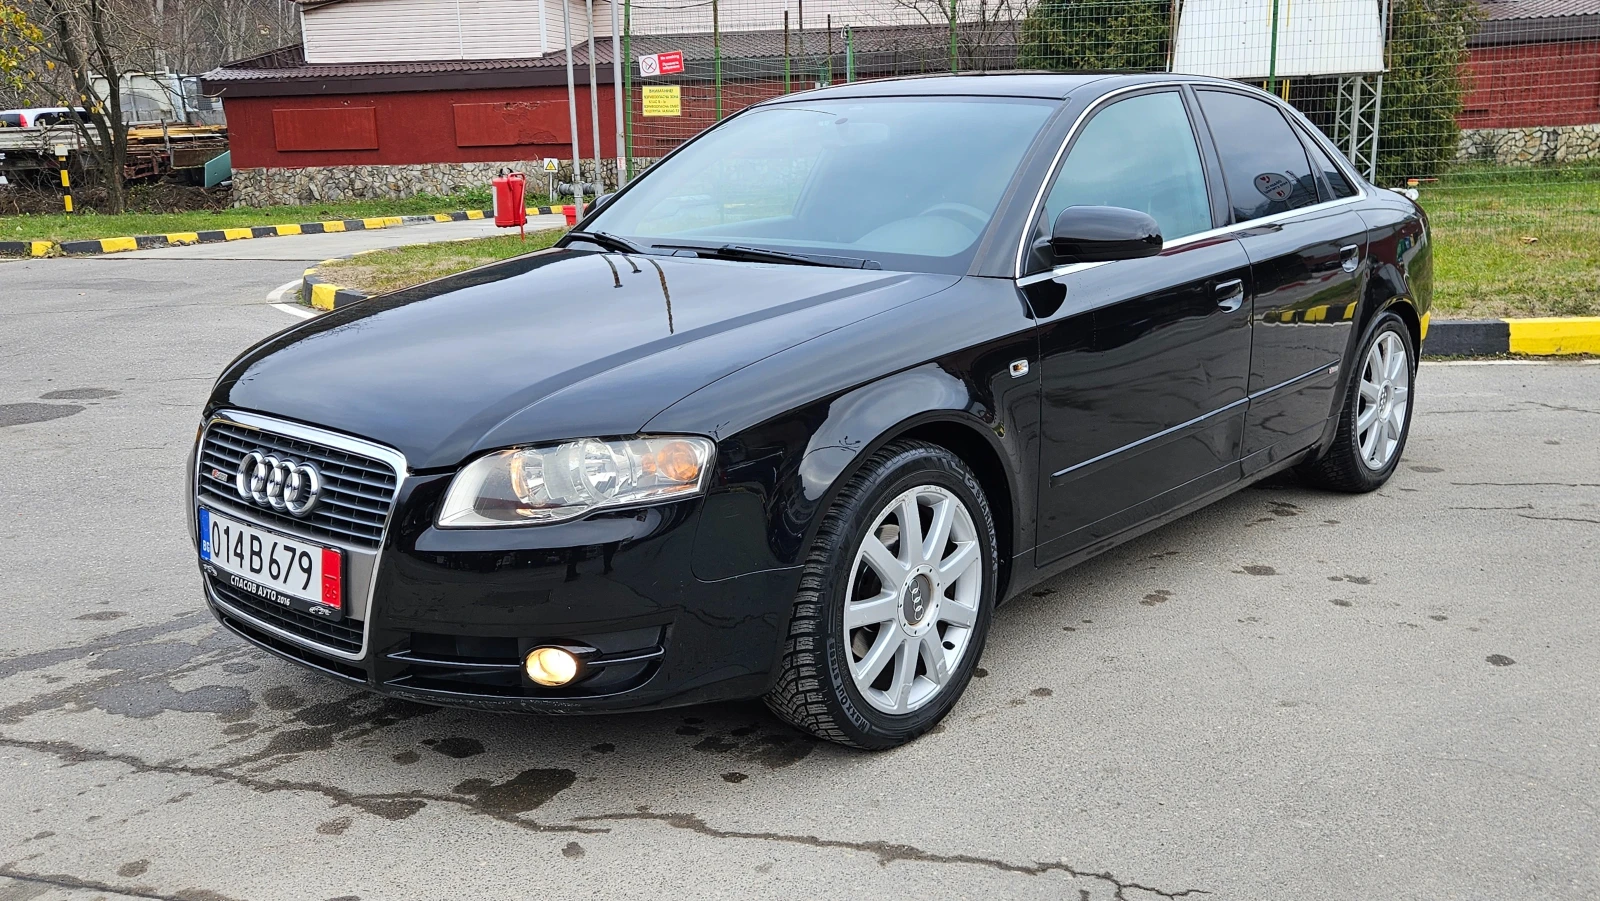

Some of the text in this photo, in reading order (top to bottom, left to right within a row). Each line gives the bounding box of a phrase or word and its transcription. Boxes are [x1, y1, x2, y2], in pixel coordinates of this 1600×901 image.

[202, 539, 211, 553] BG
[975, 489, 998, 565] STARMAXX
[211, 520, 313, 591] 014B679
[230, 575, 291, 606] СПАСОВ АУТО 2016
